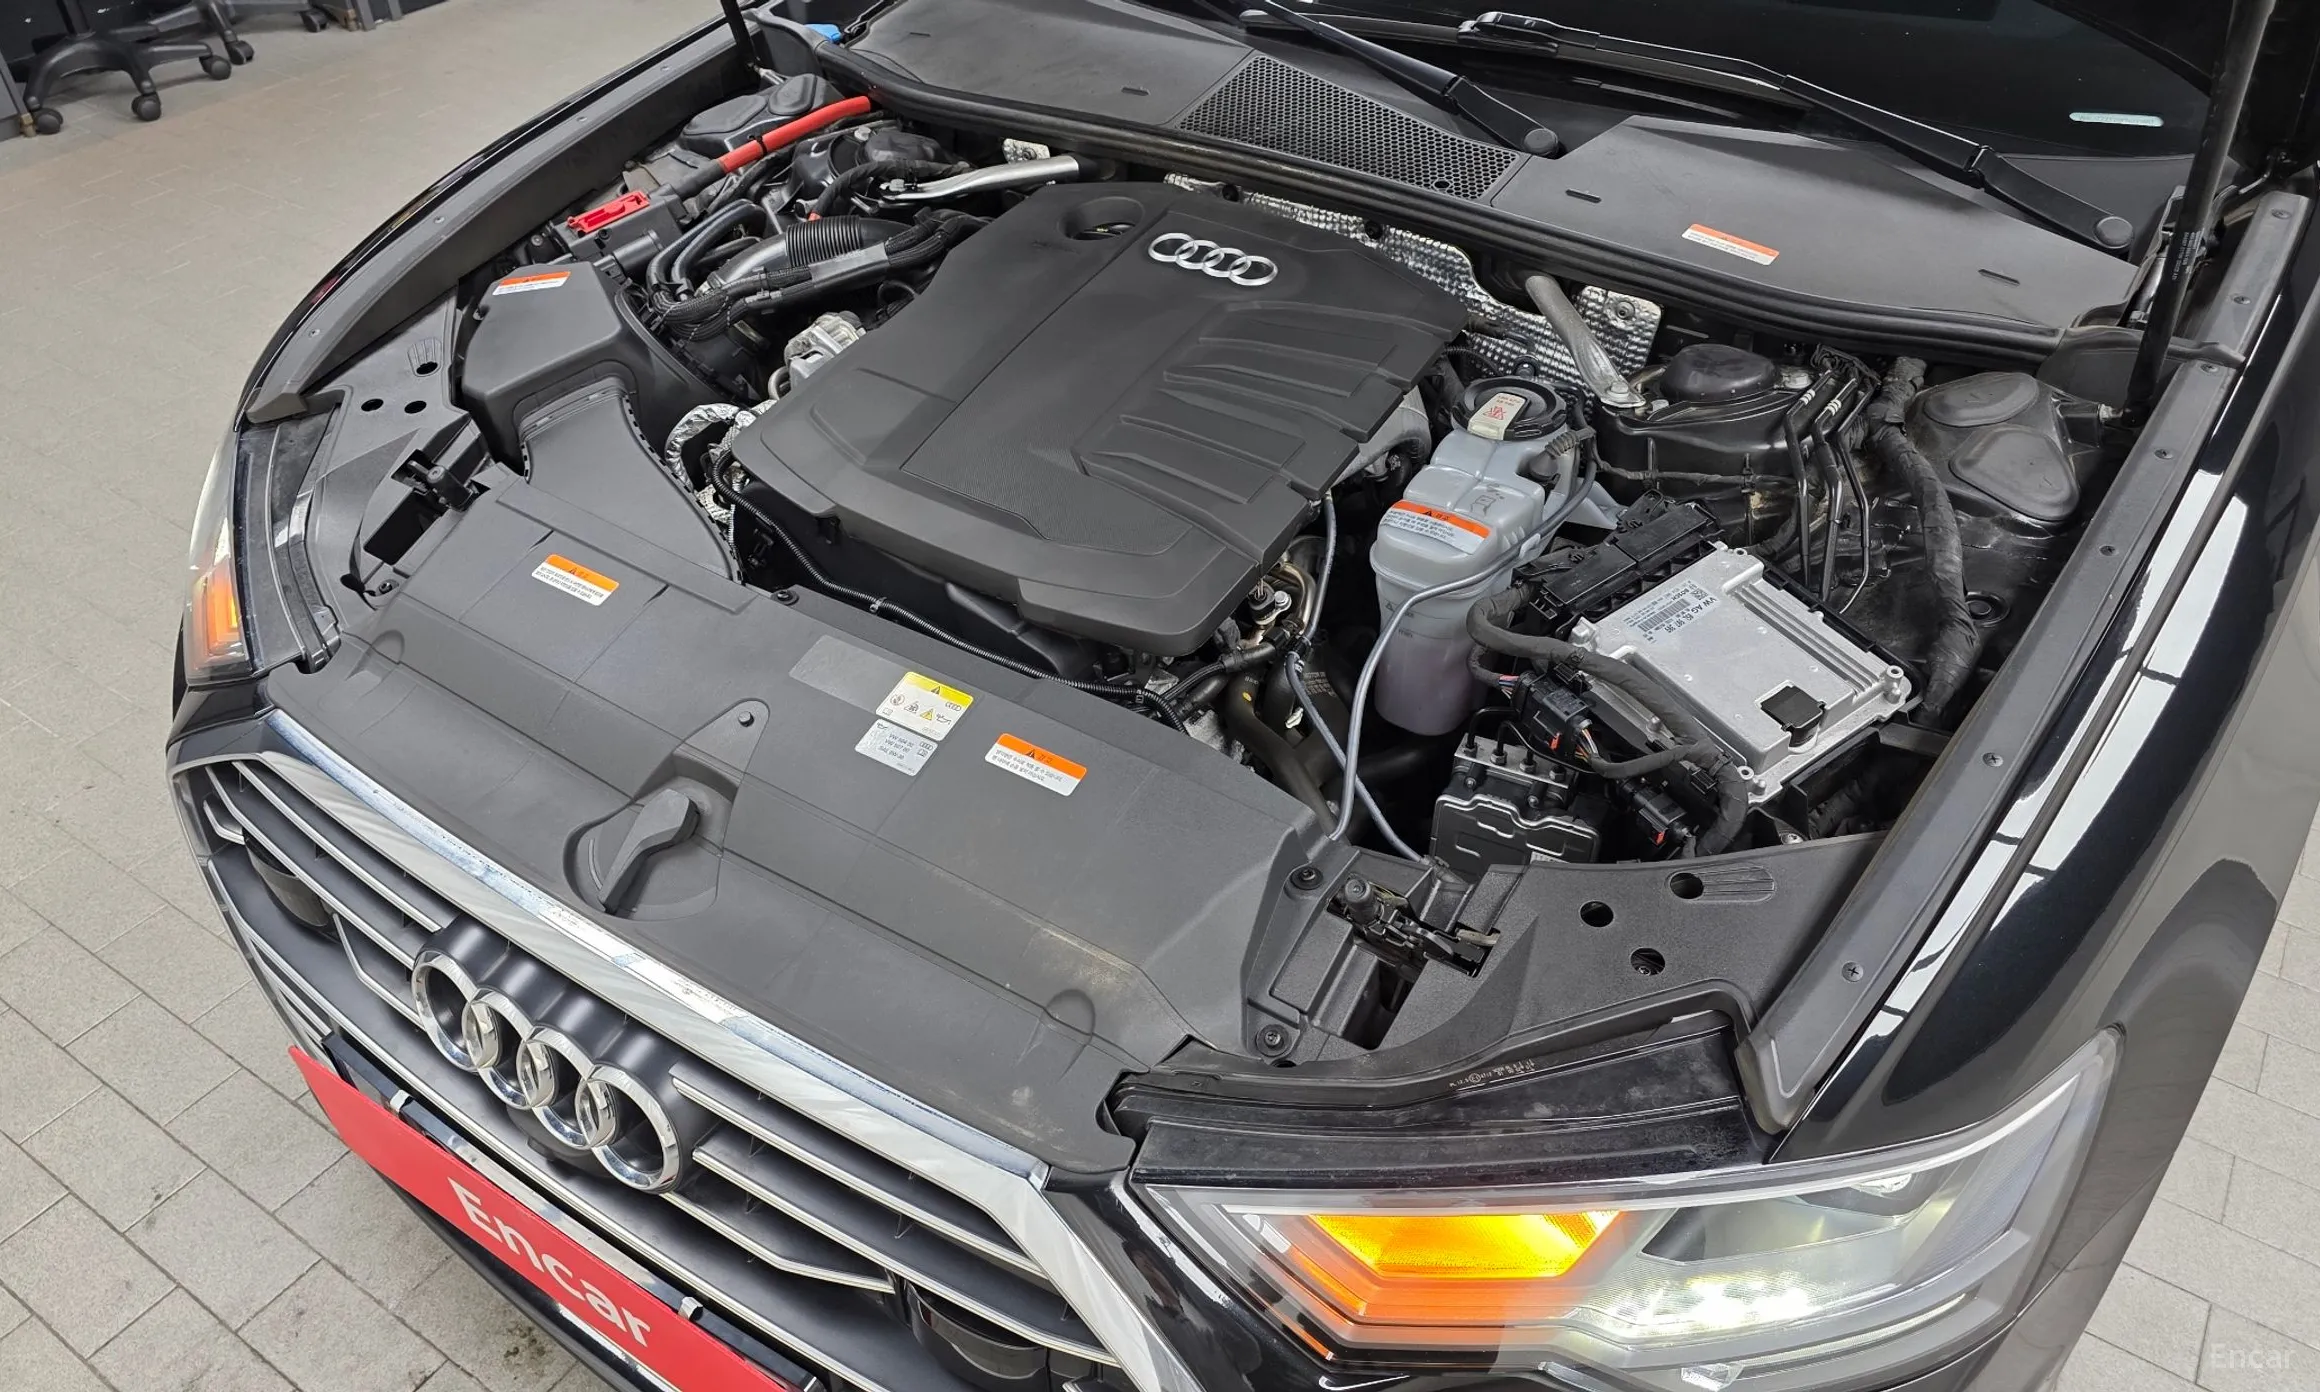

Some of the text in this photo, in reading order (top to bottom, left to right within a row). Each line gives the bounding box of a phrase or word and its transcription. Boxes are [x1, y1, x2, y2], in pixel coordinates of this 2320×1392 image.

[1702, 596, 1718, 607] VW
[1690, 604, 1703, 614] AG
[447, 1176, 652, 1348] Encar
